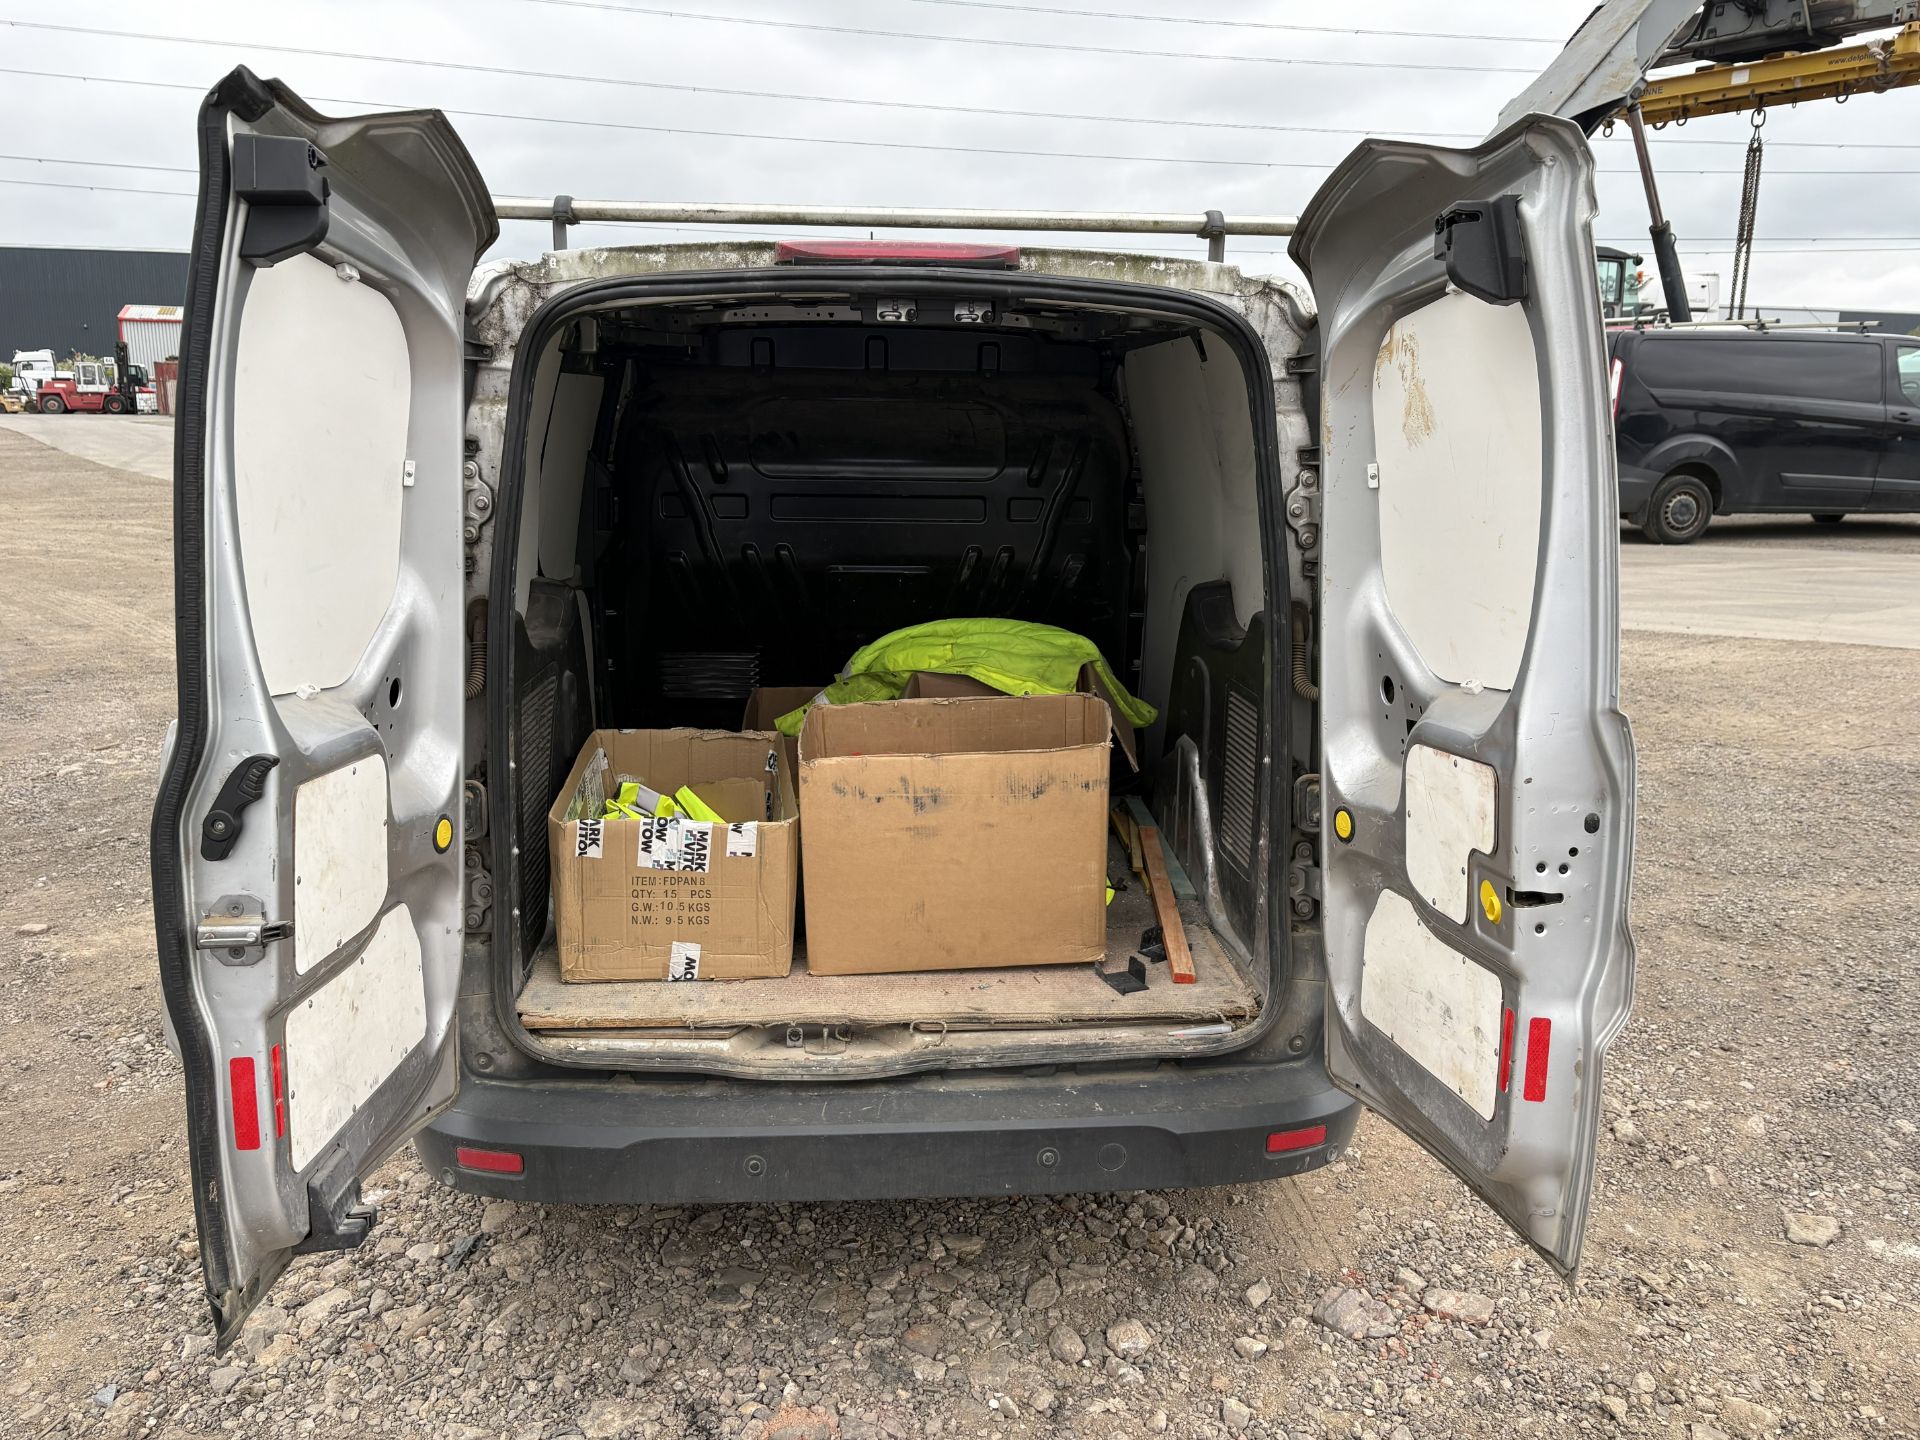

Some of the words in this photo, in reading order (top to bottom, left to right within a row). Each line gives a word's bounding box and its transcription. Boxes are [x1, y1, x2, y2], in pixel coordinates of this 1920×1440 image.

[694, 830, 709, 873] MARK
[631, 889, 656, 899] QTY:
[663, 889, 677, 899] 15
[690, 889, 712, 899] PCS
[688, 902, 711, 912] KGS
[687, 915, 710, 925] KGS
